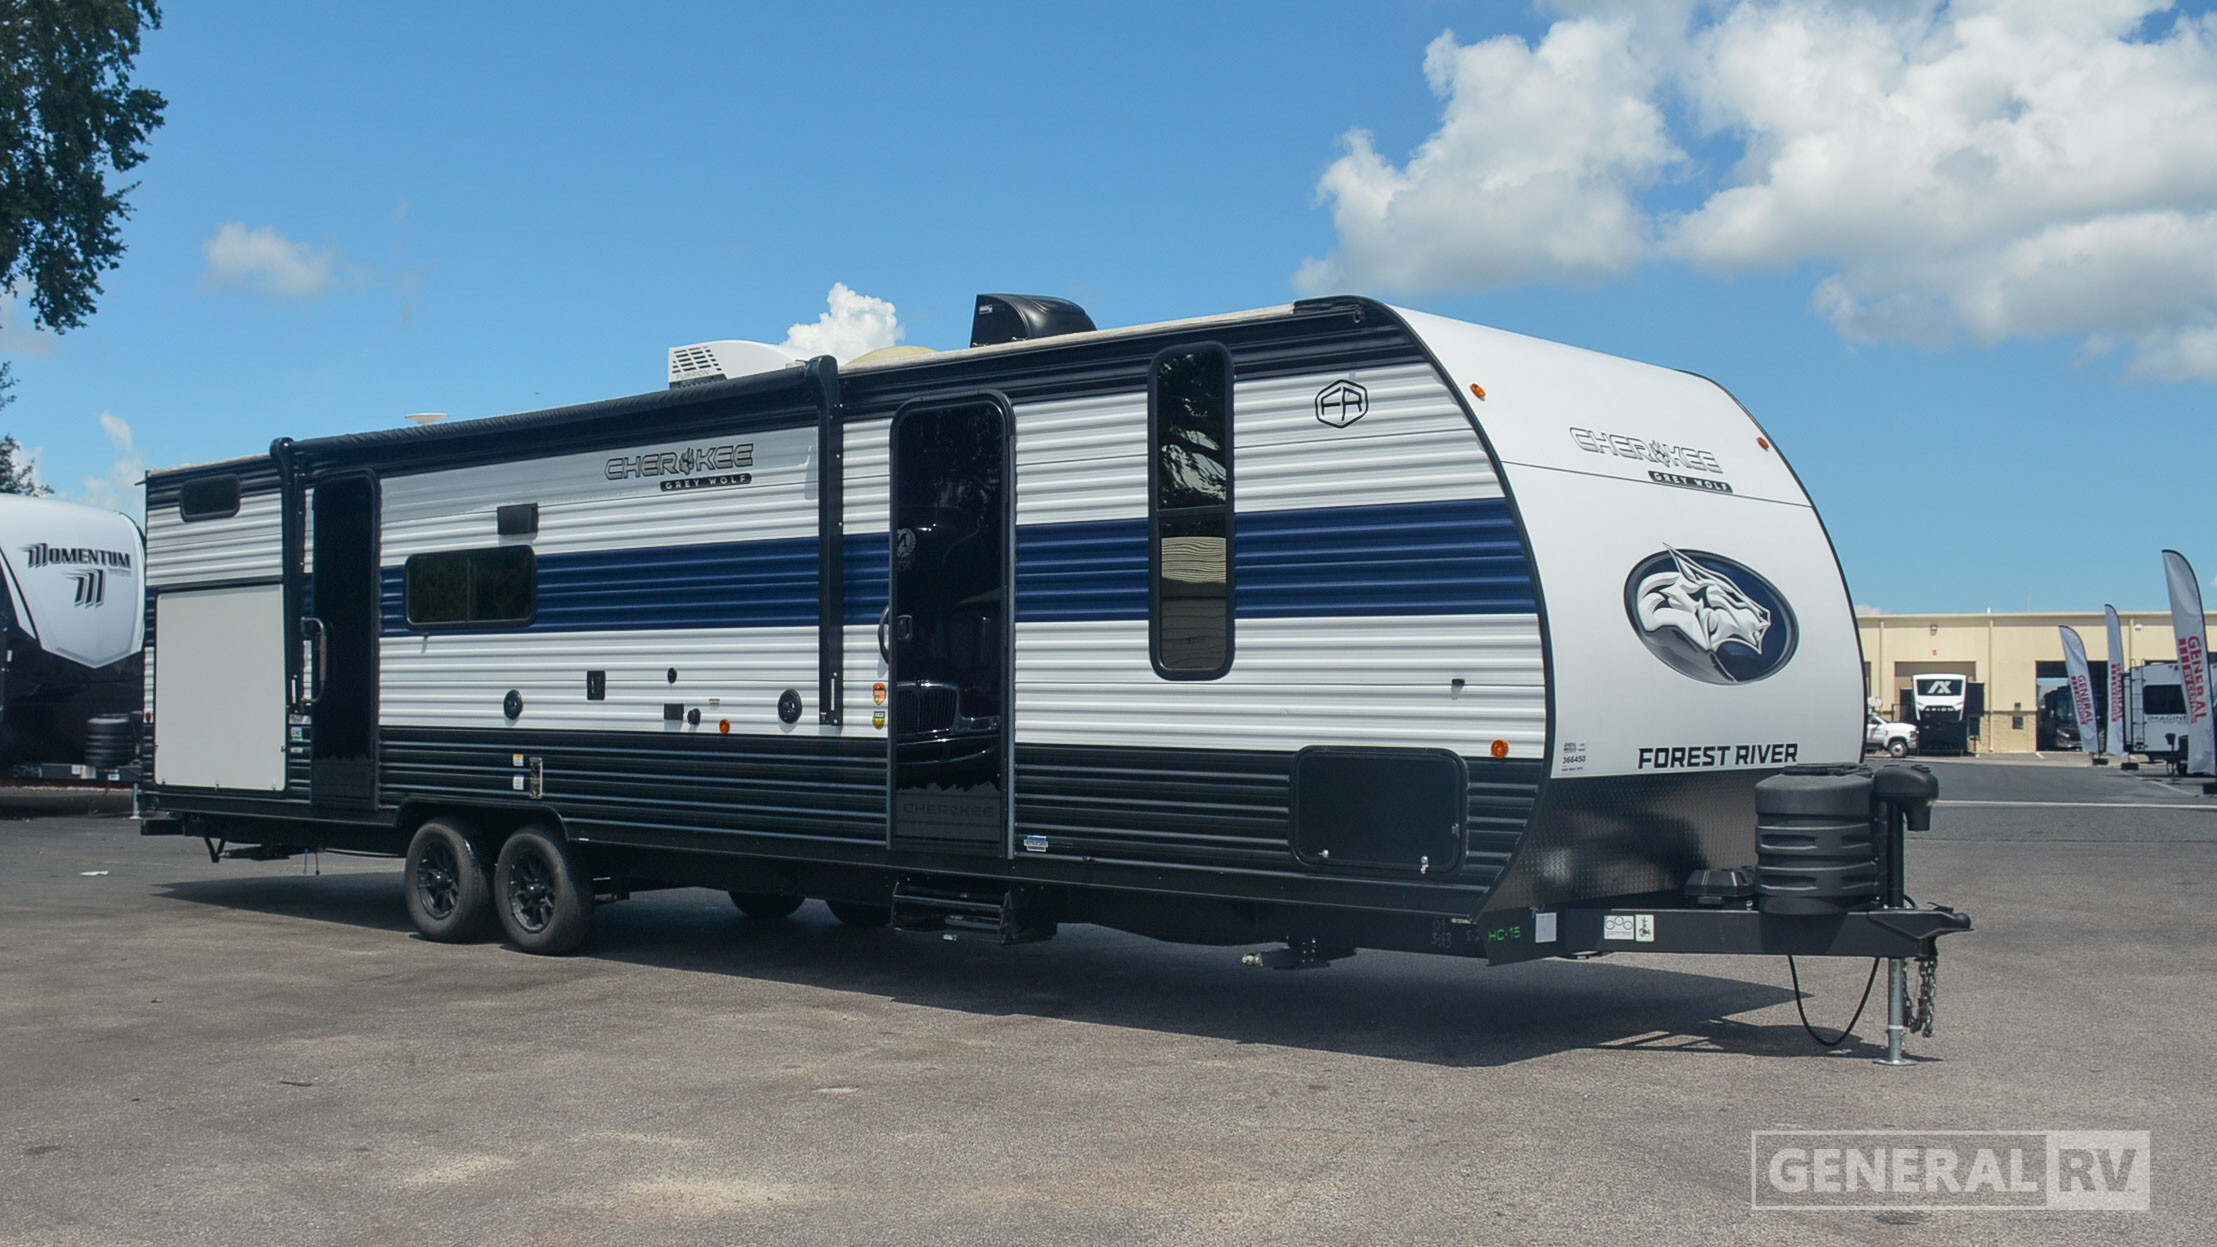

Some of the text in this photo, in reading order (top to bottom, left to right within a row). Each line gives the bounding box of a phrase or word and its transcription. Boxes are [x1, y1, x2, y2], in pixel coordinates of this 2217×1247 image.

[605, 443, 754, 480] CHEROKEE
[1569, 427, 1724, 474] CHEROKEE
[665, 476, 747, 490] GREY WOLF
[1653, 472, 1729, 492] GREY WOLF
[22, 543, 131, 568] MOMENTUM
[2187, 636, 2208, 719] GENERAL
[2077, 674, 2093, 722] GENERAL
[1638, 743, 1798, 769] FOREST RIVER
